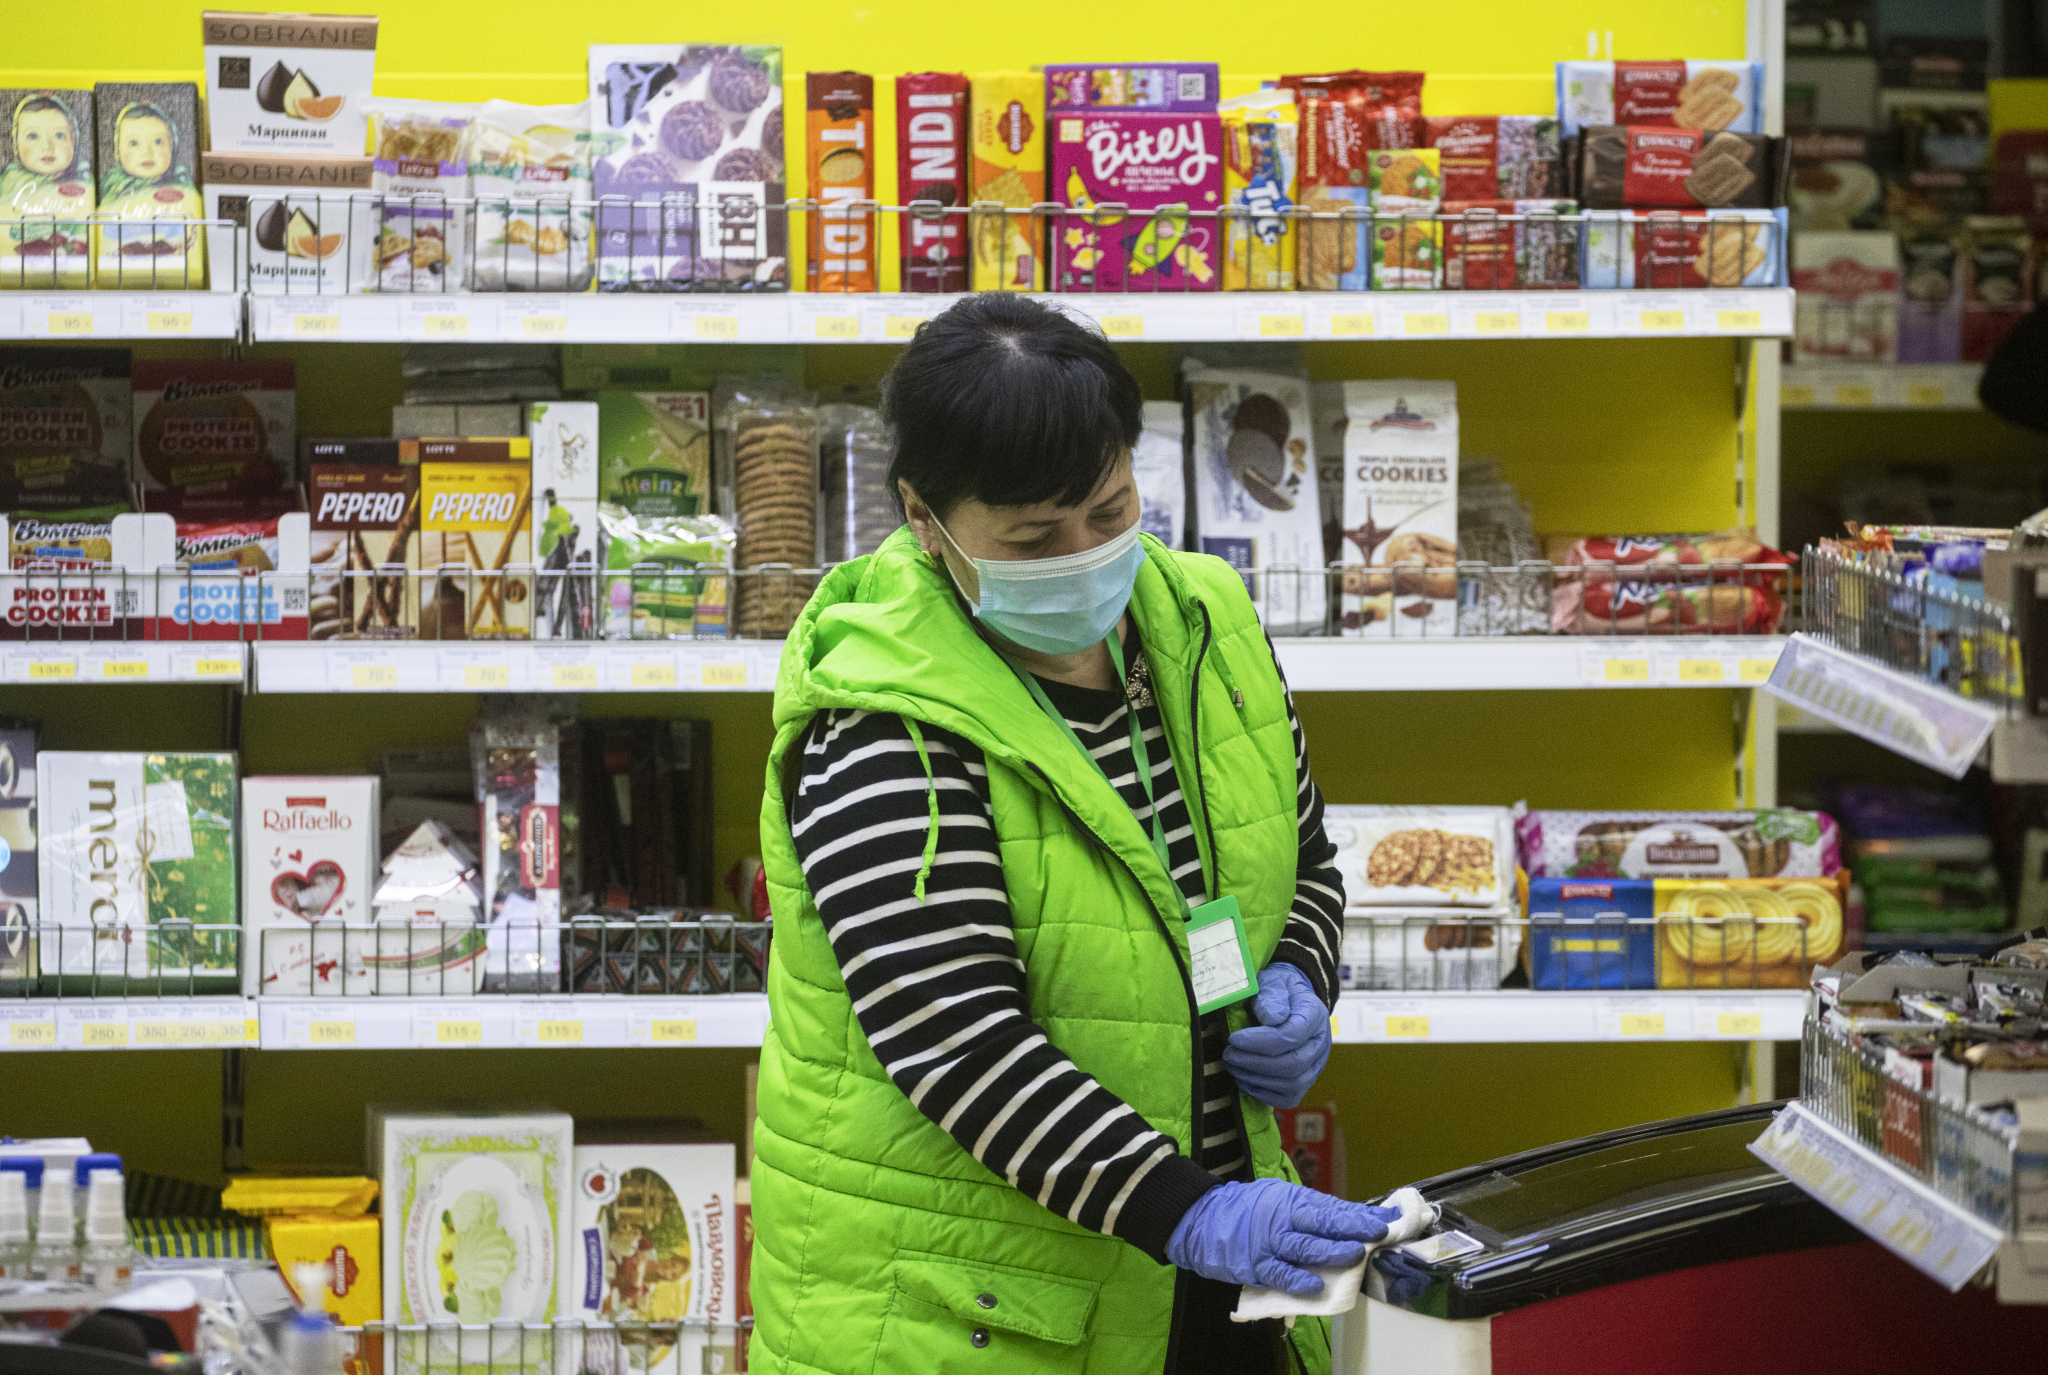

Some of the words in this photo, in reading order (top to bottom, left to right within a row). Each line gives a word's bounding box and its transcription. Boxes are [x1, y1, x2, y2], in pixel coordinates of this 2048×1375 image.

[208, 21, 370, 44] SOBRANIE
[248, 123, 327, 140] Марципан
[1087, 120, 1218, 186] Bitey
[207, 161, 369, 184] SOBRANIE
[909, 94, 958, 246] TONDI
[821, 121, 867, 272] TONDI
[303, 319, 327, 330] 200
[315, 444, 346, 455] LOTTE
[426, 444, 457, 455] LOTTE
[624, 473, 683, 495] Heinz
[1357, 467, 1448, 483] COOKIES
[317, 492, 406, 523] PEPERO
[428, 492, 516, 522] PEPERO
[13, 588, 105, 601] PROTEIN
[179, 585, 274, 600] PROTEIN
[8, 606, 112, 622] COOKIE
[173, 603, 281, 622] COOKIE
[264, 809, 351, 832] Raffaello
[18, 1027, 41, 1039] 200
